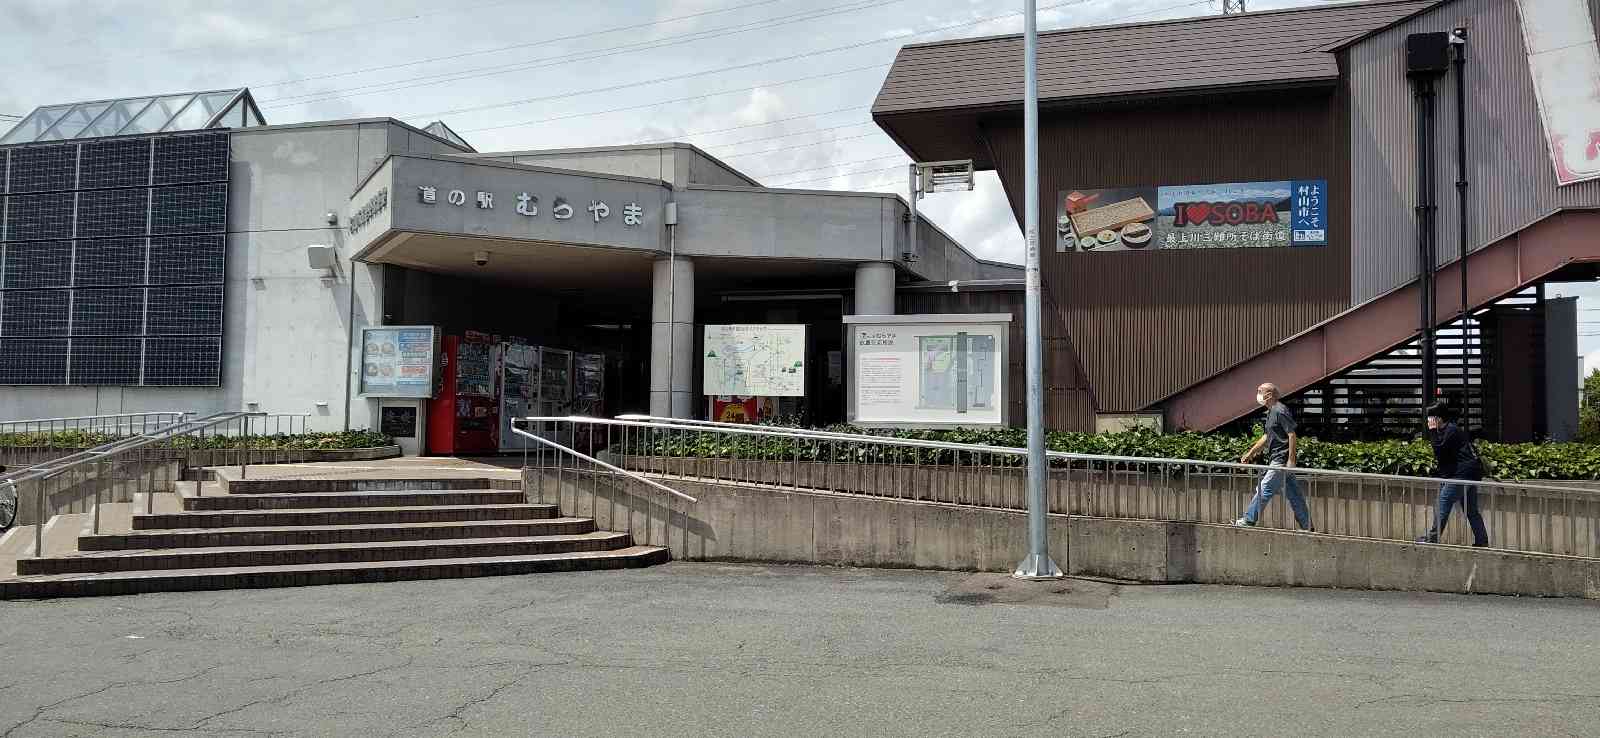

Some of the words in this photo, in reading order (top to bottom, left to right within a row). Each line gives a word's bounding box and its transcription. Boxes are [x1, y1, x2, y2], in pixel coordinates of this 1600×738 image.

[418, 185, 494, 209] 道の駅
[516, 192, 643, 225] むらやま
[1210, 202, 1279, 226] SOBA
[1298, 184, 1310, 226] 村山市へ
[1310, 184, 1321, 228] ようこそ
